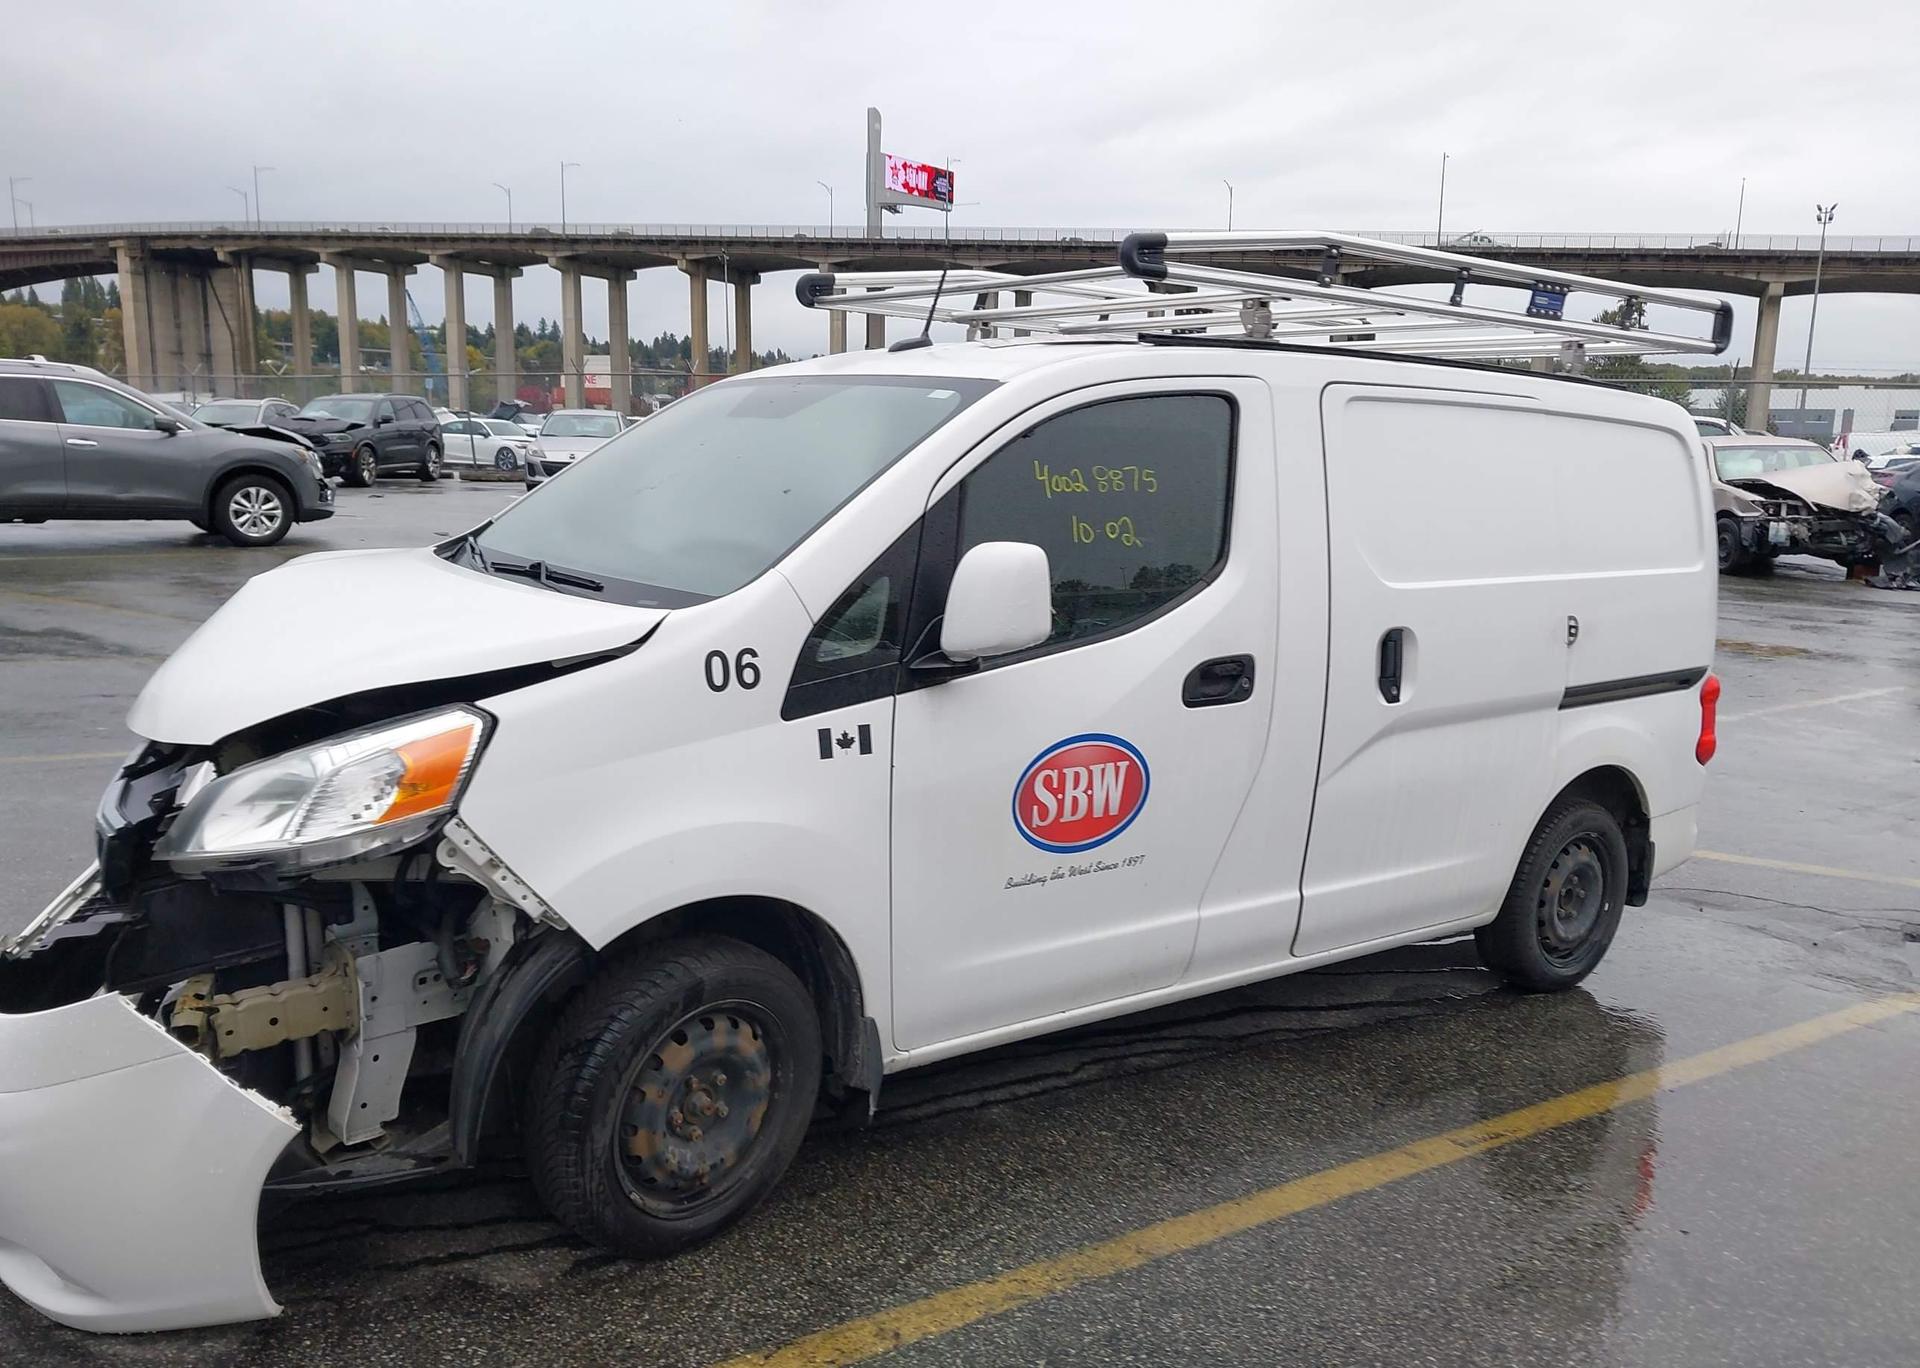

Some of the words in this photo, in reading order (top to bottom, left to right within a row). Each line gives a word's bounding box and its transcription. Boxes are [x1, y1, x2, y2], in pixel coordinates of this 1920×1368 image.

[584, 375, 597, 384] NE
[705, 647, 761, 692] 06
[1004, 873, 1048, 889] Building
[1050, 866, 1066, 880] the
[1069, 862, 1092, 877] West
[1093, 860, 1119, 872] Since
